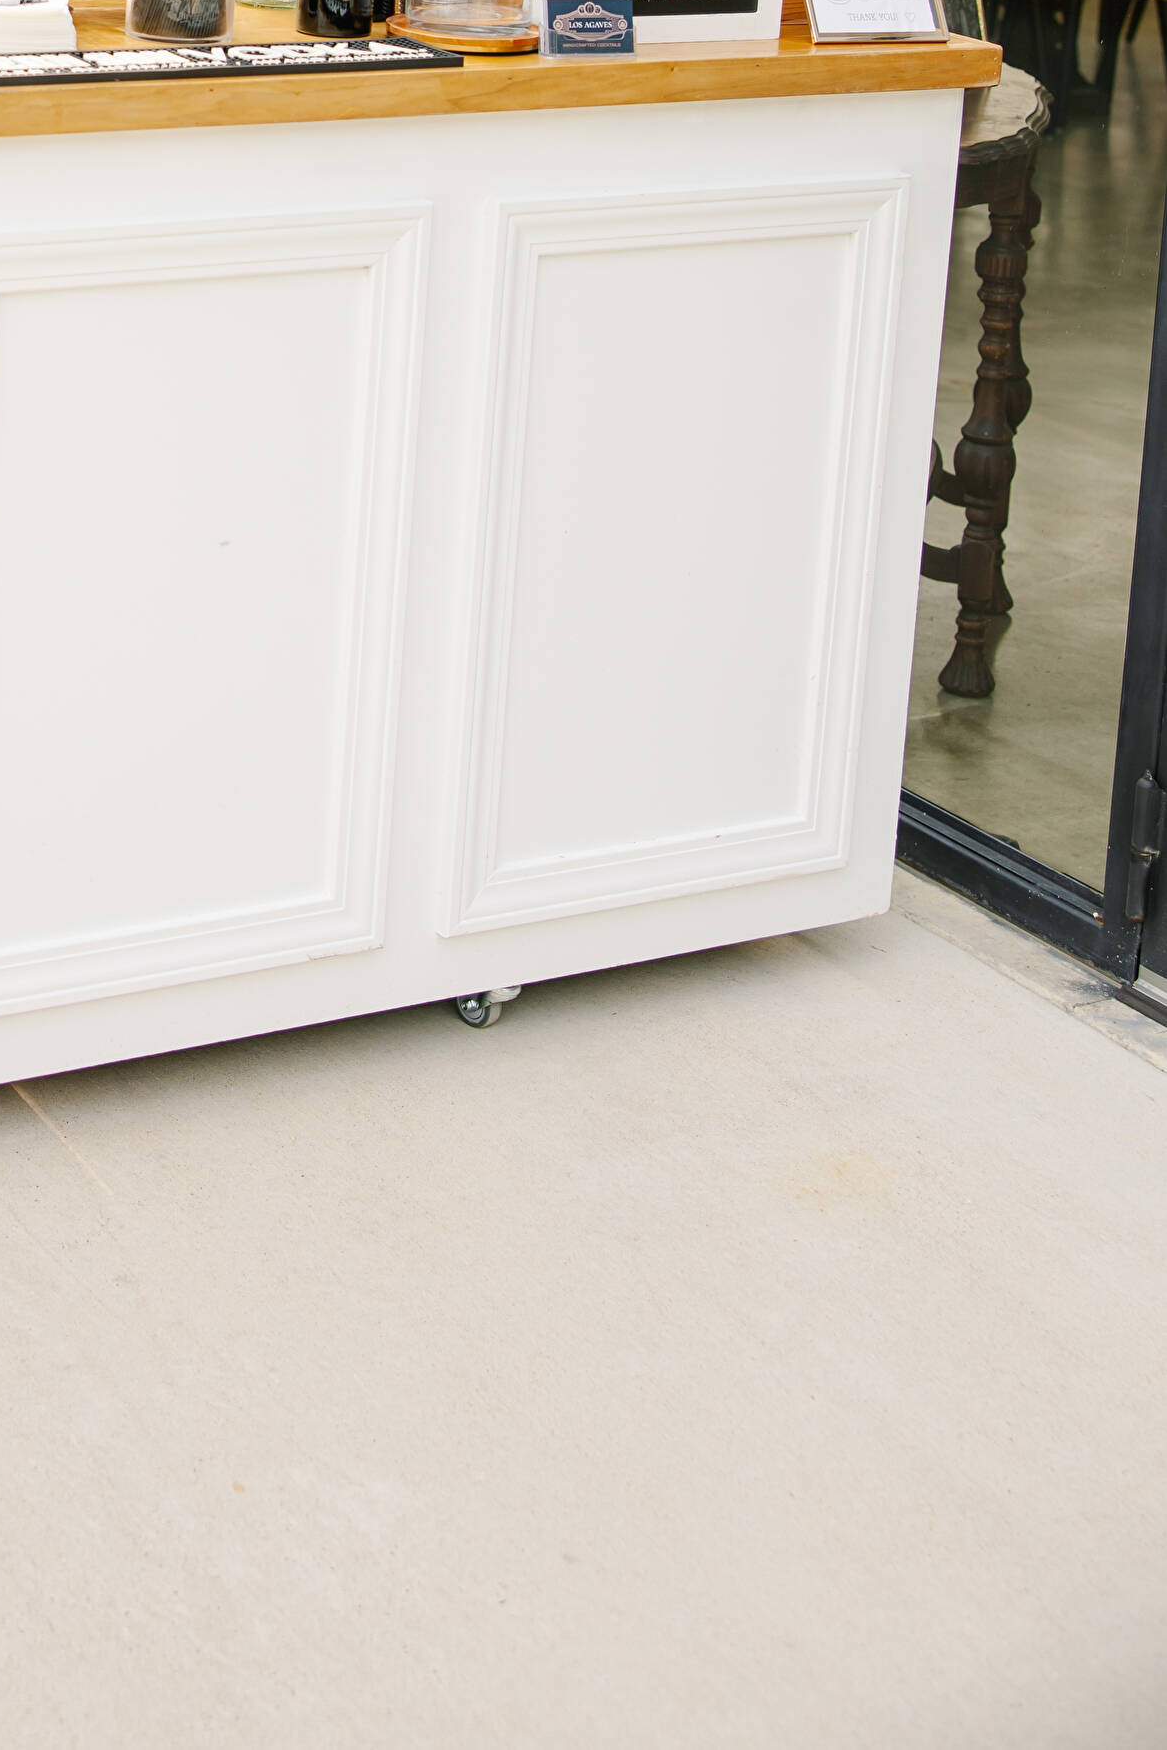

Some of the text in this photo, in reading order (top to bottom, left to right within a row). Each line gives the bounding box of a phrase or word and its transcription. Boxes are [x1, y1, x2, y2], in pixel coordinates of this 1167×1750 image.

[847, 12, 898, 22] THANK YOU!
[569, 21, 613, 29] LOS AGAVES
[177, 41, 428, 63] VODKA
